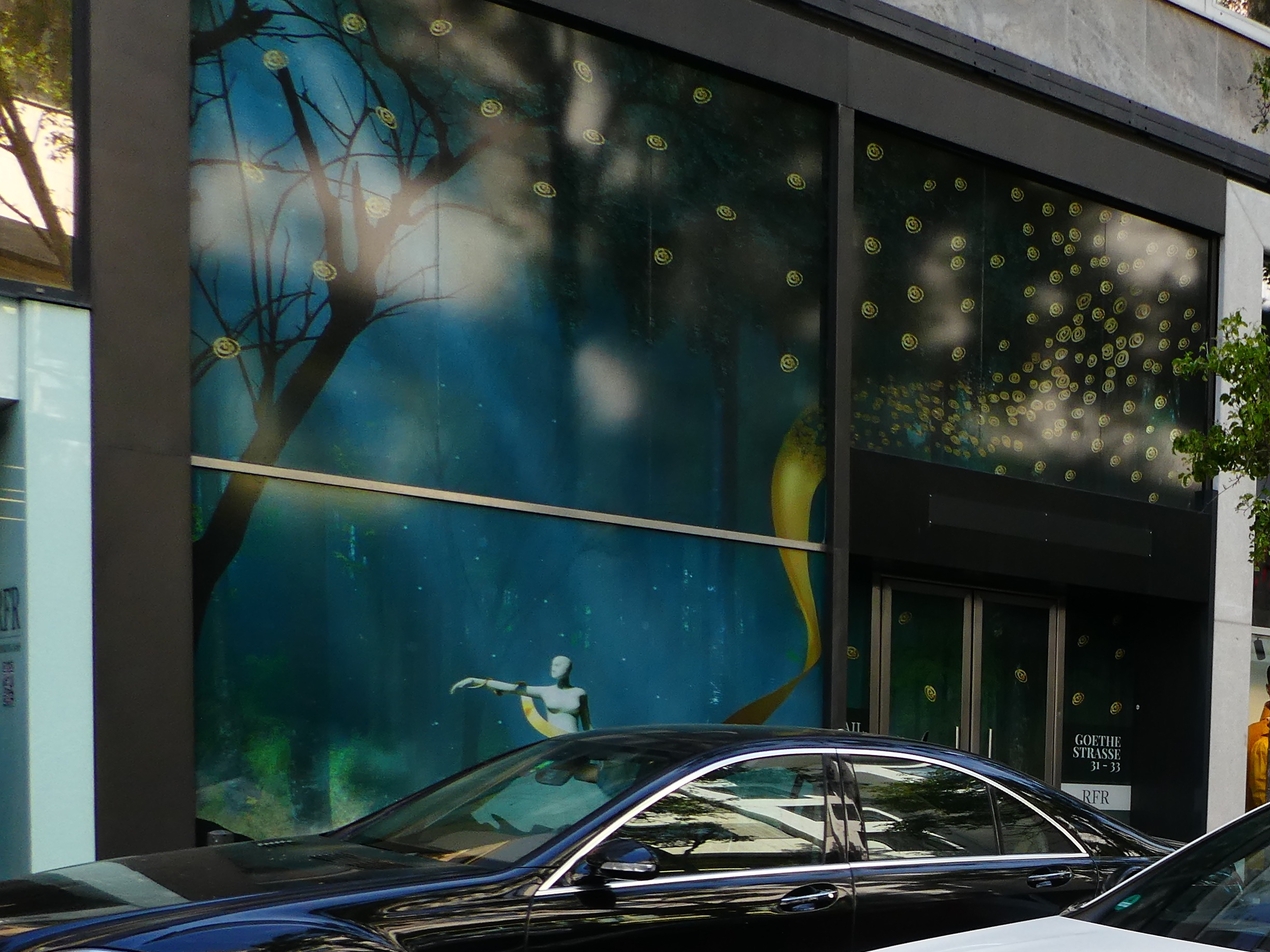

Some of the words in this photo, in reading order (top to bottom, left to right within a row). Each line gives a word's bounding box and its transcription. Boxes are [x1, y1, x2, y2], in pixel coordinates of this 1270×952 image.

[1075, 733, 1122, 747] GOETHE
[1072, 746, 1121, 760] STRASSE
[1090, 760, 1100, 772] 31
[1110, 761, 1121, 773] 33
[1082, 789, 1109, 804] RFR
